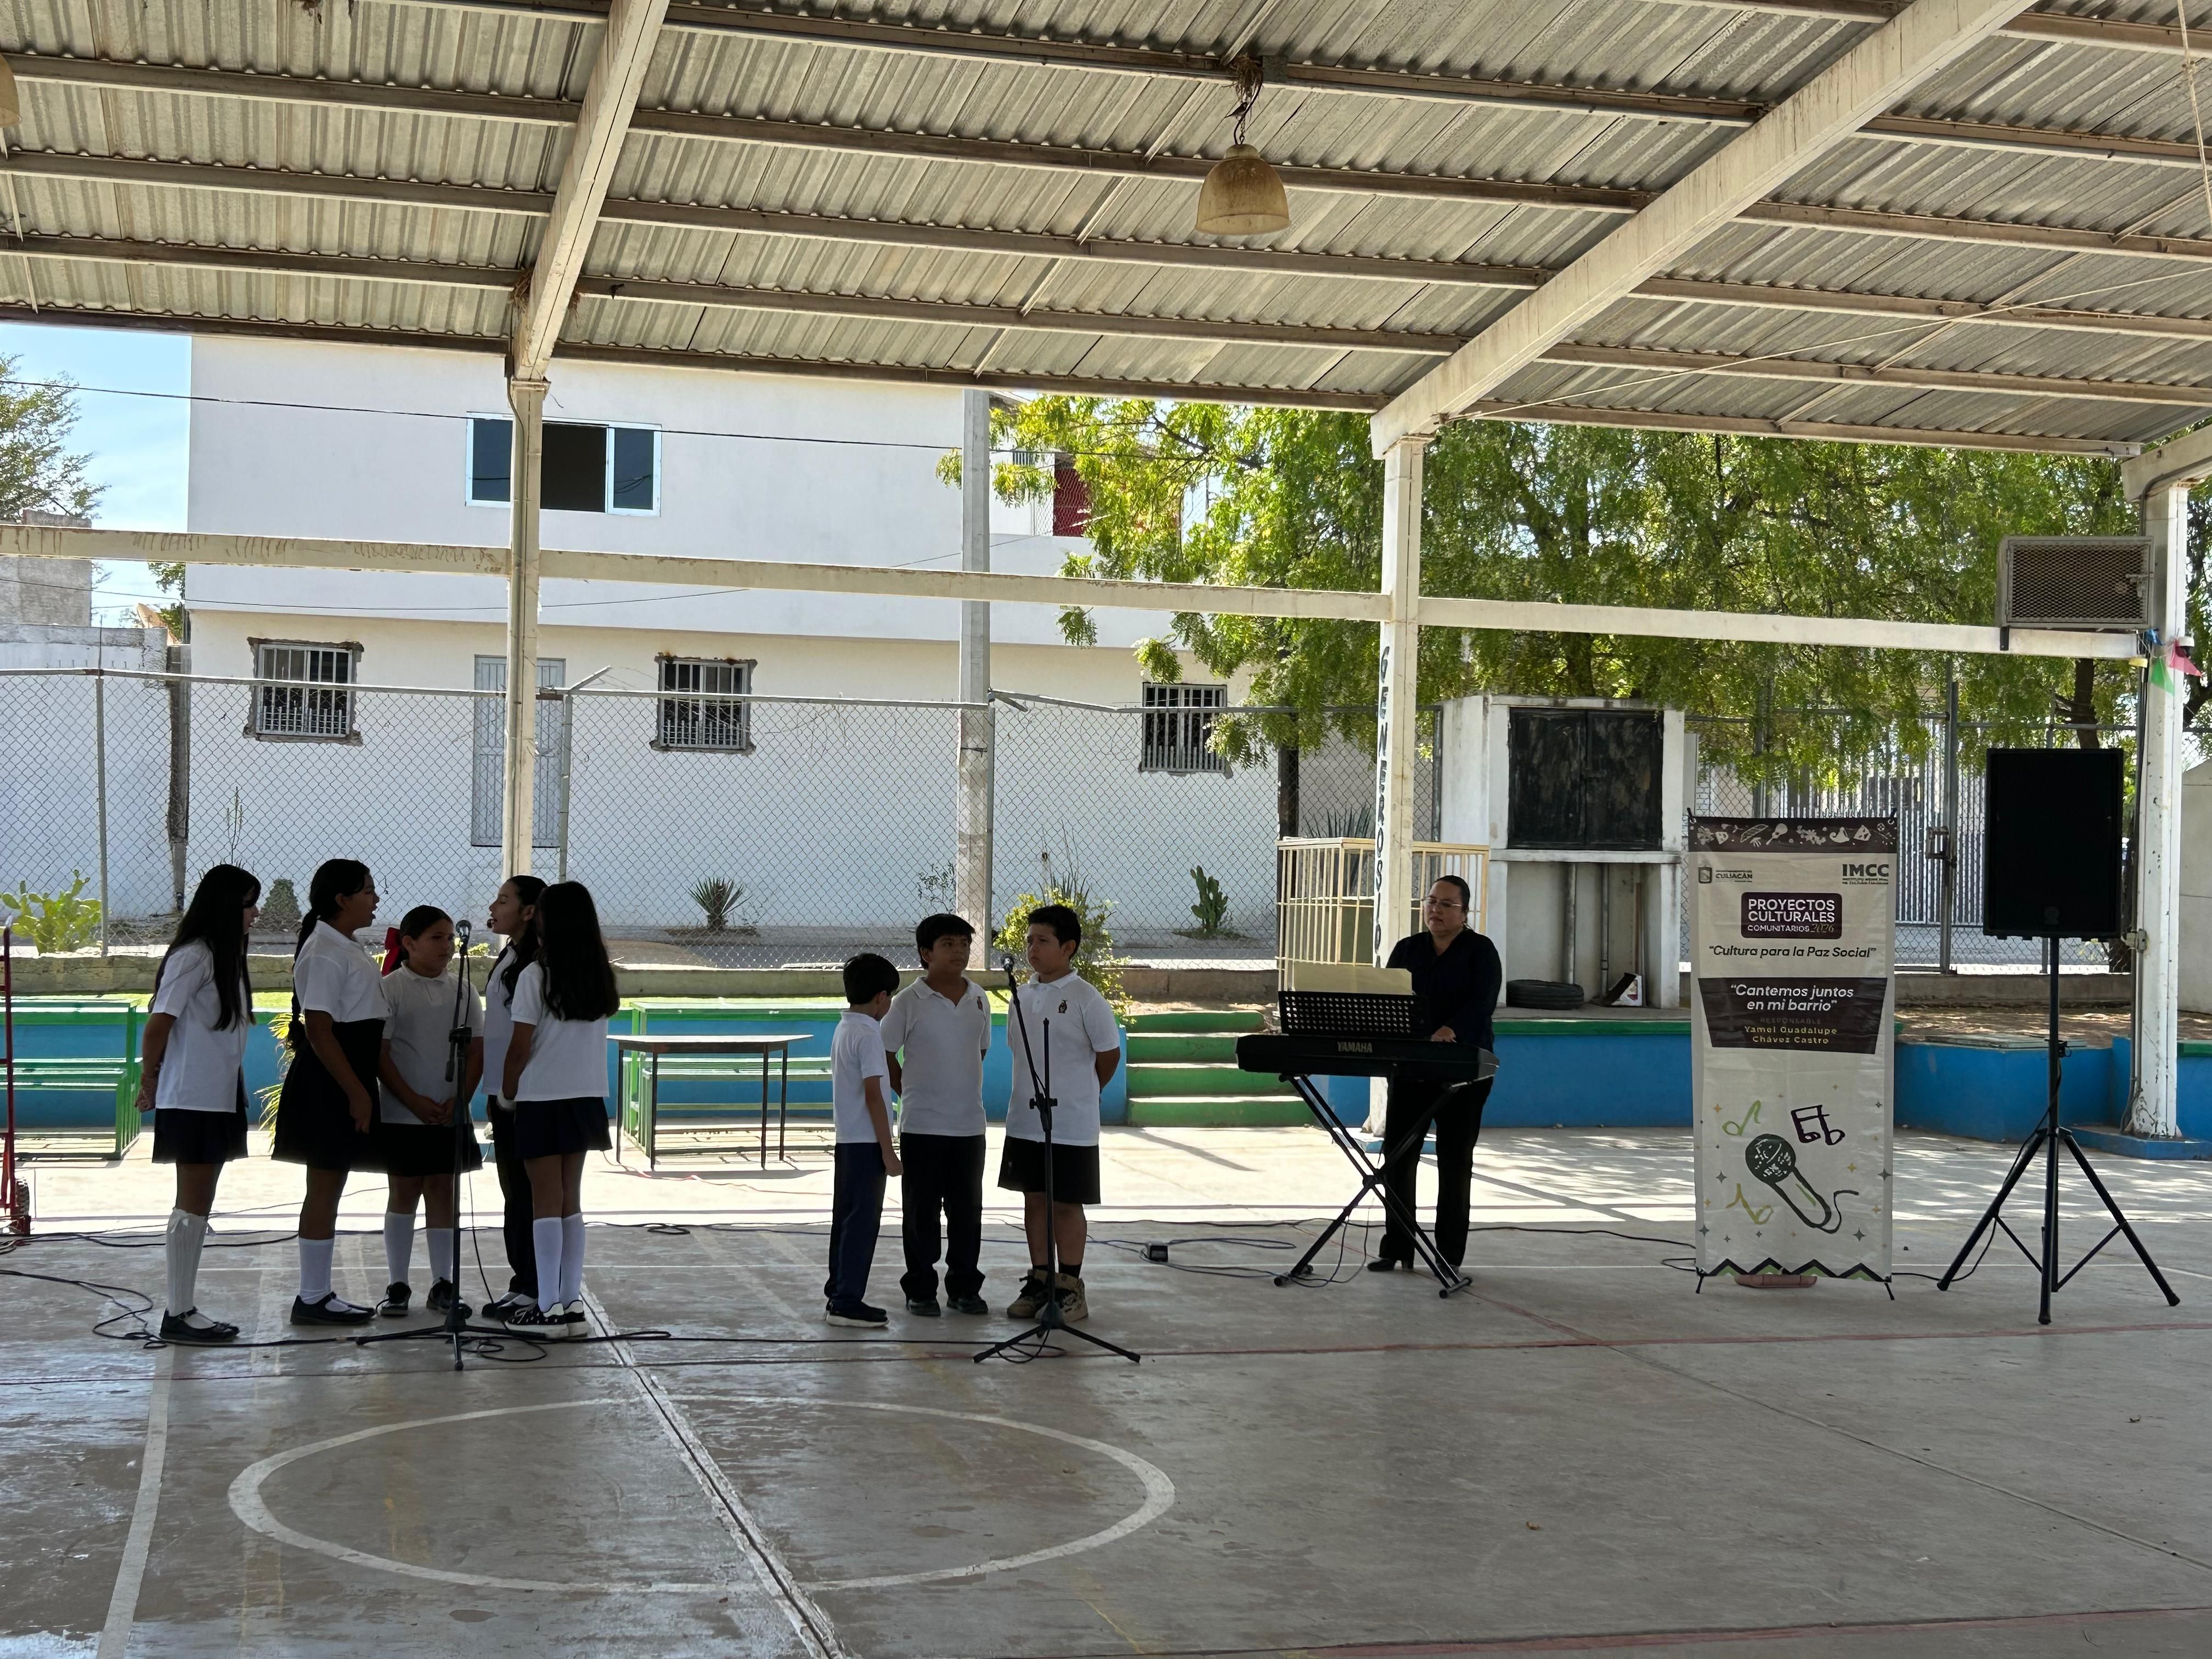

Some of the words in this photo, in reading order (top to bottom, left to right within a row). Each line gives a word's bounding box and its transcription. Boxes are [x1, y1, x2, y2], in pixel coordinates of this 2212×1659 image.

[1842, 864, 1889, 877] IMCC
[1748, 899, 1835, 911] PROYECTOS
[1748, 911, 1835, 923] CULTURALES
[1760, 949, 1790, 958] para
[1793, 946, 1804, 956] la
[1807, 946, 1830, 957] Paz
[1809, 985, 1854, 1000] juntos
[1747, 1001, 1764, 1011] en
[1767, 999, 1786, 1011] mi
[1780, 1026, 1837, 1035] Guadalupe
[1337, 1041, 1373, 1053] YAMAHA
